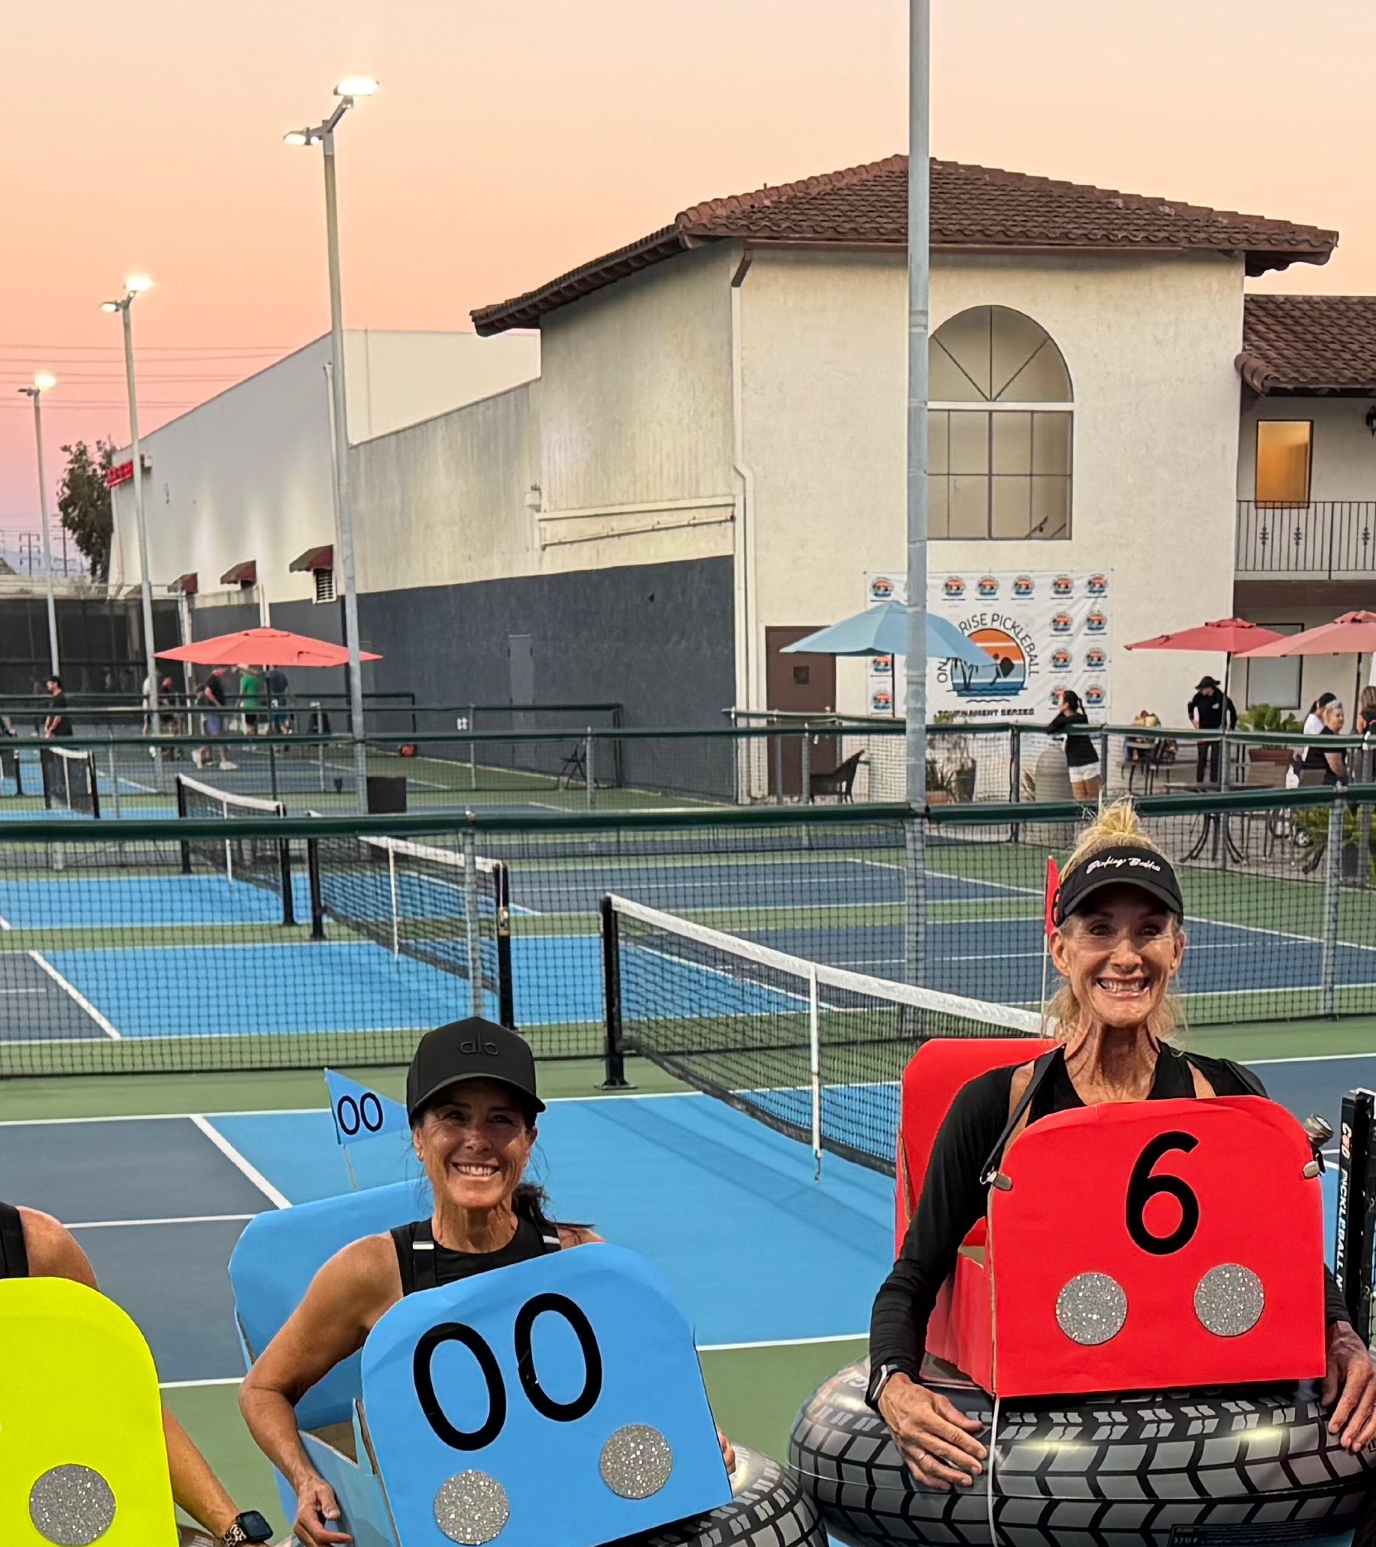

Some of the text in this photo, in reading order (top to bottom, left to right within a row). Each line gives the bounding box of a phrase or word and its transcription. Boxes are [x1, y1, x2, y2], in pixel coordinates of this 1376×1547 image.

[991, 612, 1040, 677] PICKLEBALL
[1001, 708, 1034, 716] SERIES
[337, 1092, 384, 1136] 00
[1126, 1131, 1200, 1256] 6
[413, 1292, 603, 1452] 00
